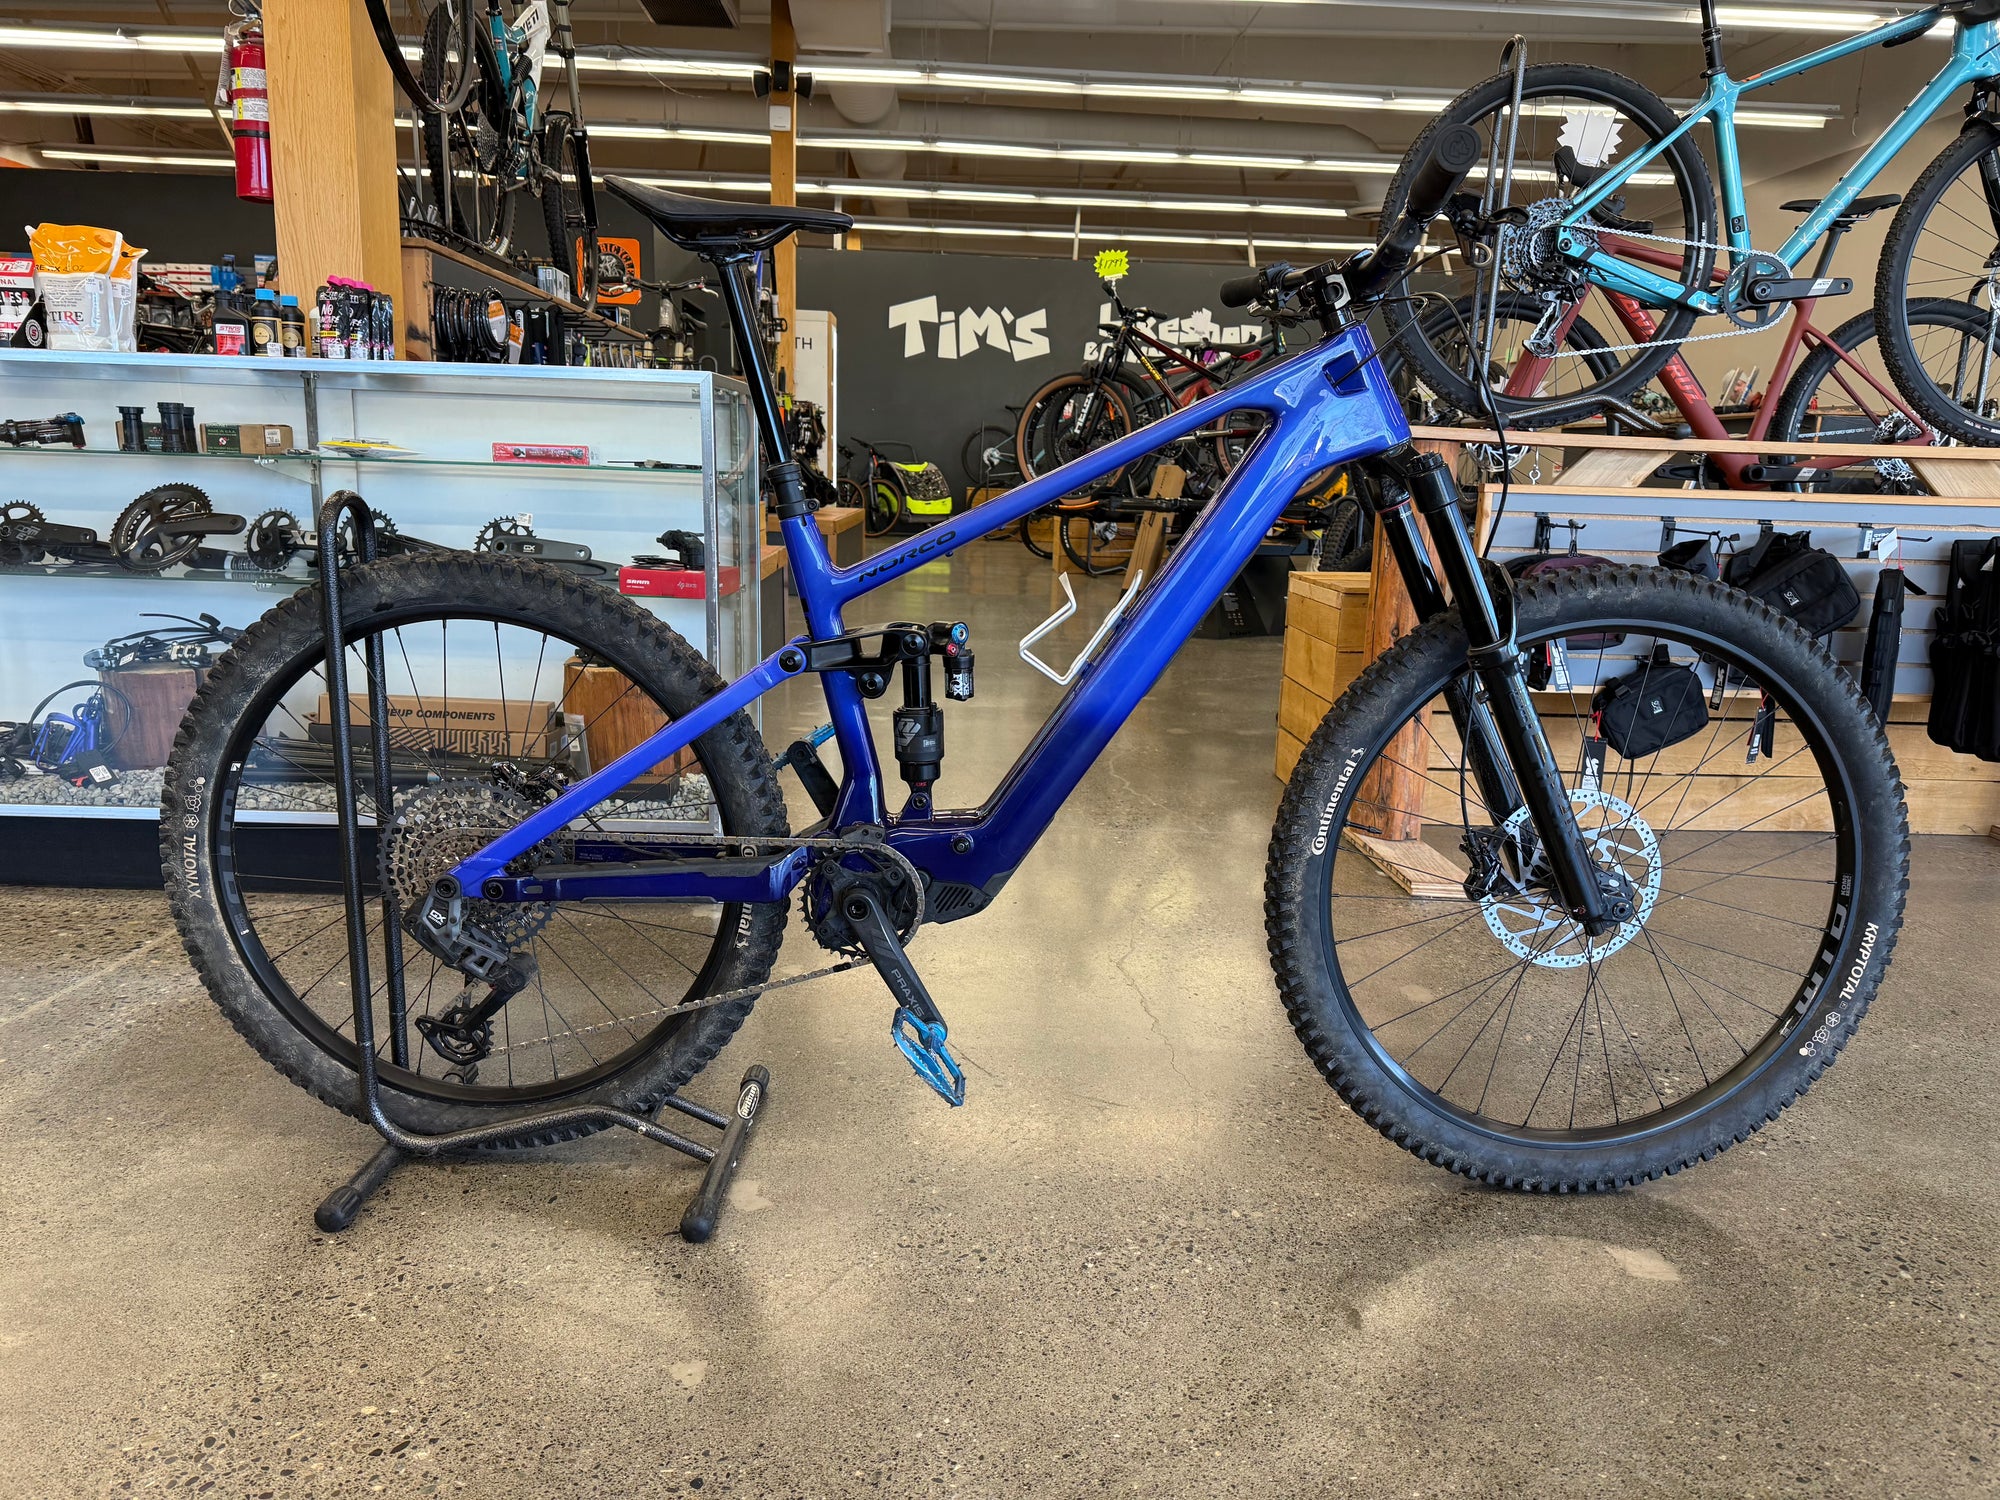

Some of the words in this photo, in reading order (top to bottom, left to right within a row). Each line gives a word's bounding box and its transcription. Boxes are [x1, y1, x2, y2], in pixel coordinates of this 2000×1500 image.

[1803, 184, 1861, 247] KONA
[859, 531, 956, 583] NORCO
[952, 673, 964, 696] FOX
[416, 709, 496, 721] COMPONENTS
[1311, 759, 1358, 856] Continental
[184, 833, 202, 900] XYNOTAL
[429, 908, 447, 923] GX
[1839, 921, 1879, 1000] KRYPTOTAL
[890, 968, 924, 1017] PRAXIS
